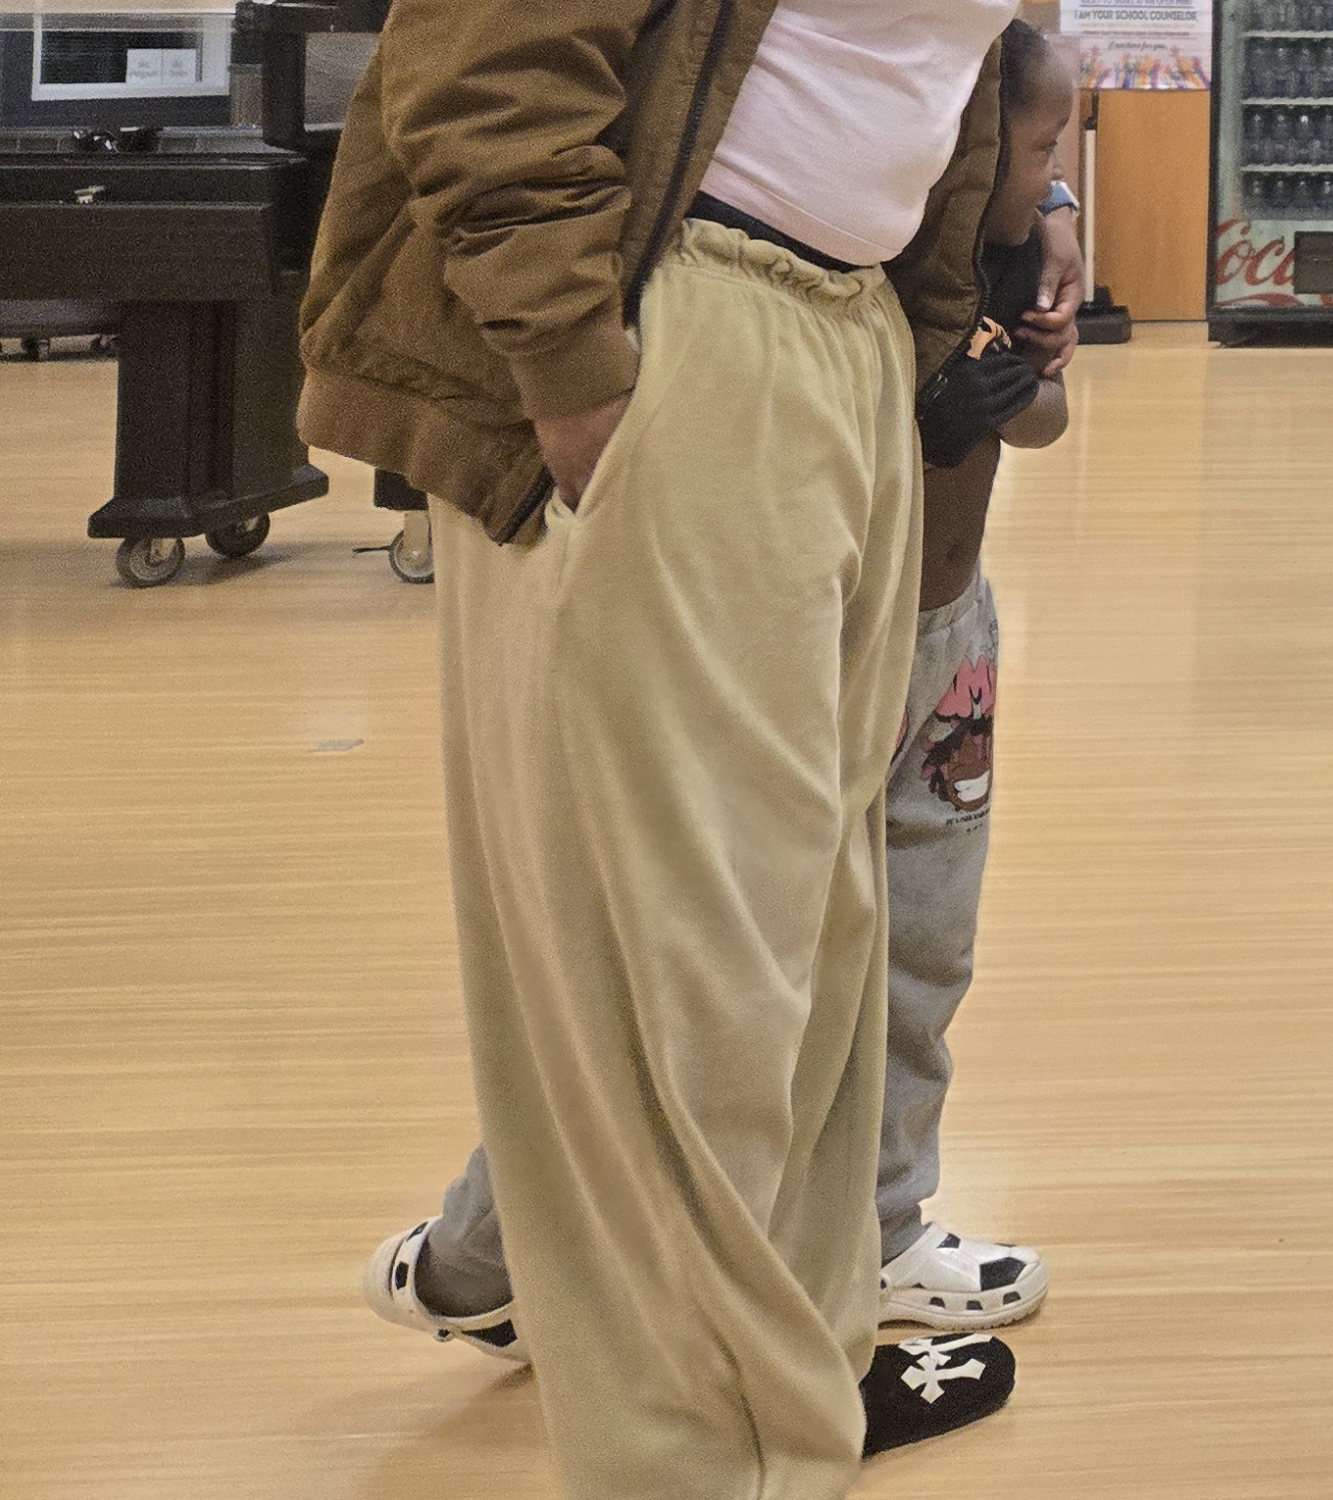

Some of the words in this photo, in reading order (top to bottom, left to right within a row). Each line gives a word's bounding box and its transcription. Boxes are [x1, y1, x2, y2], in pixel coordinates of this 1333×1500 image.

[1078, 9, 1091, 20] AM
[1092, 9, 1114, 20] YOUR
[1115, 10, 1149, 21] SCHOOL
